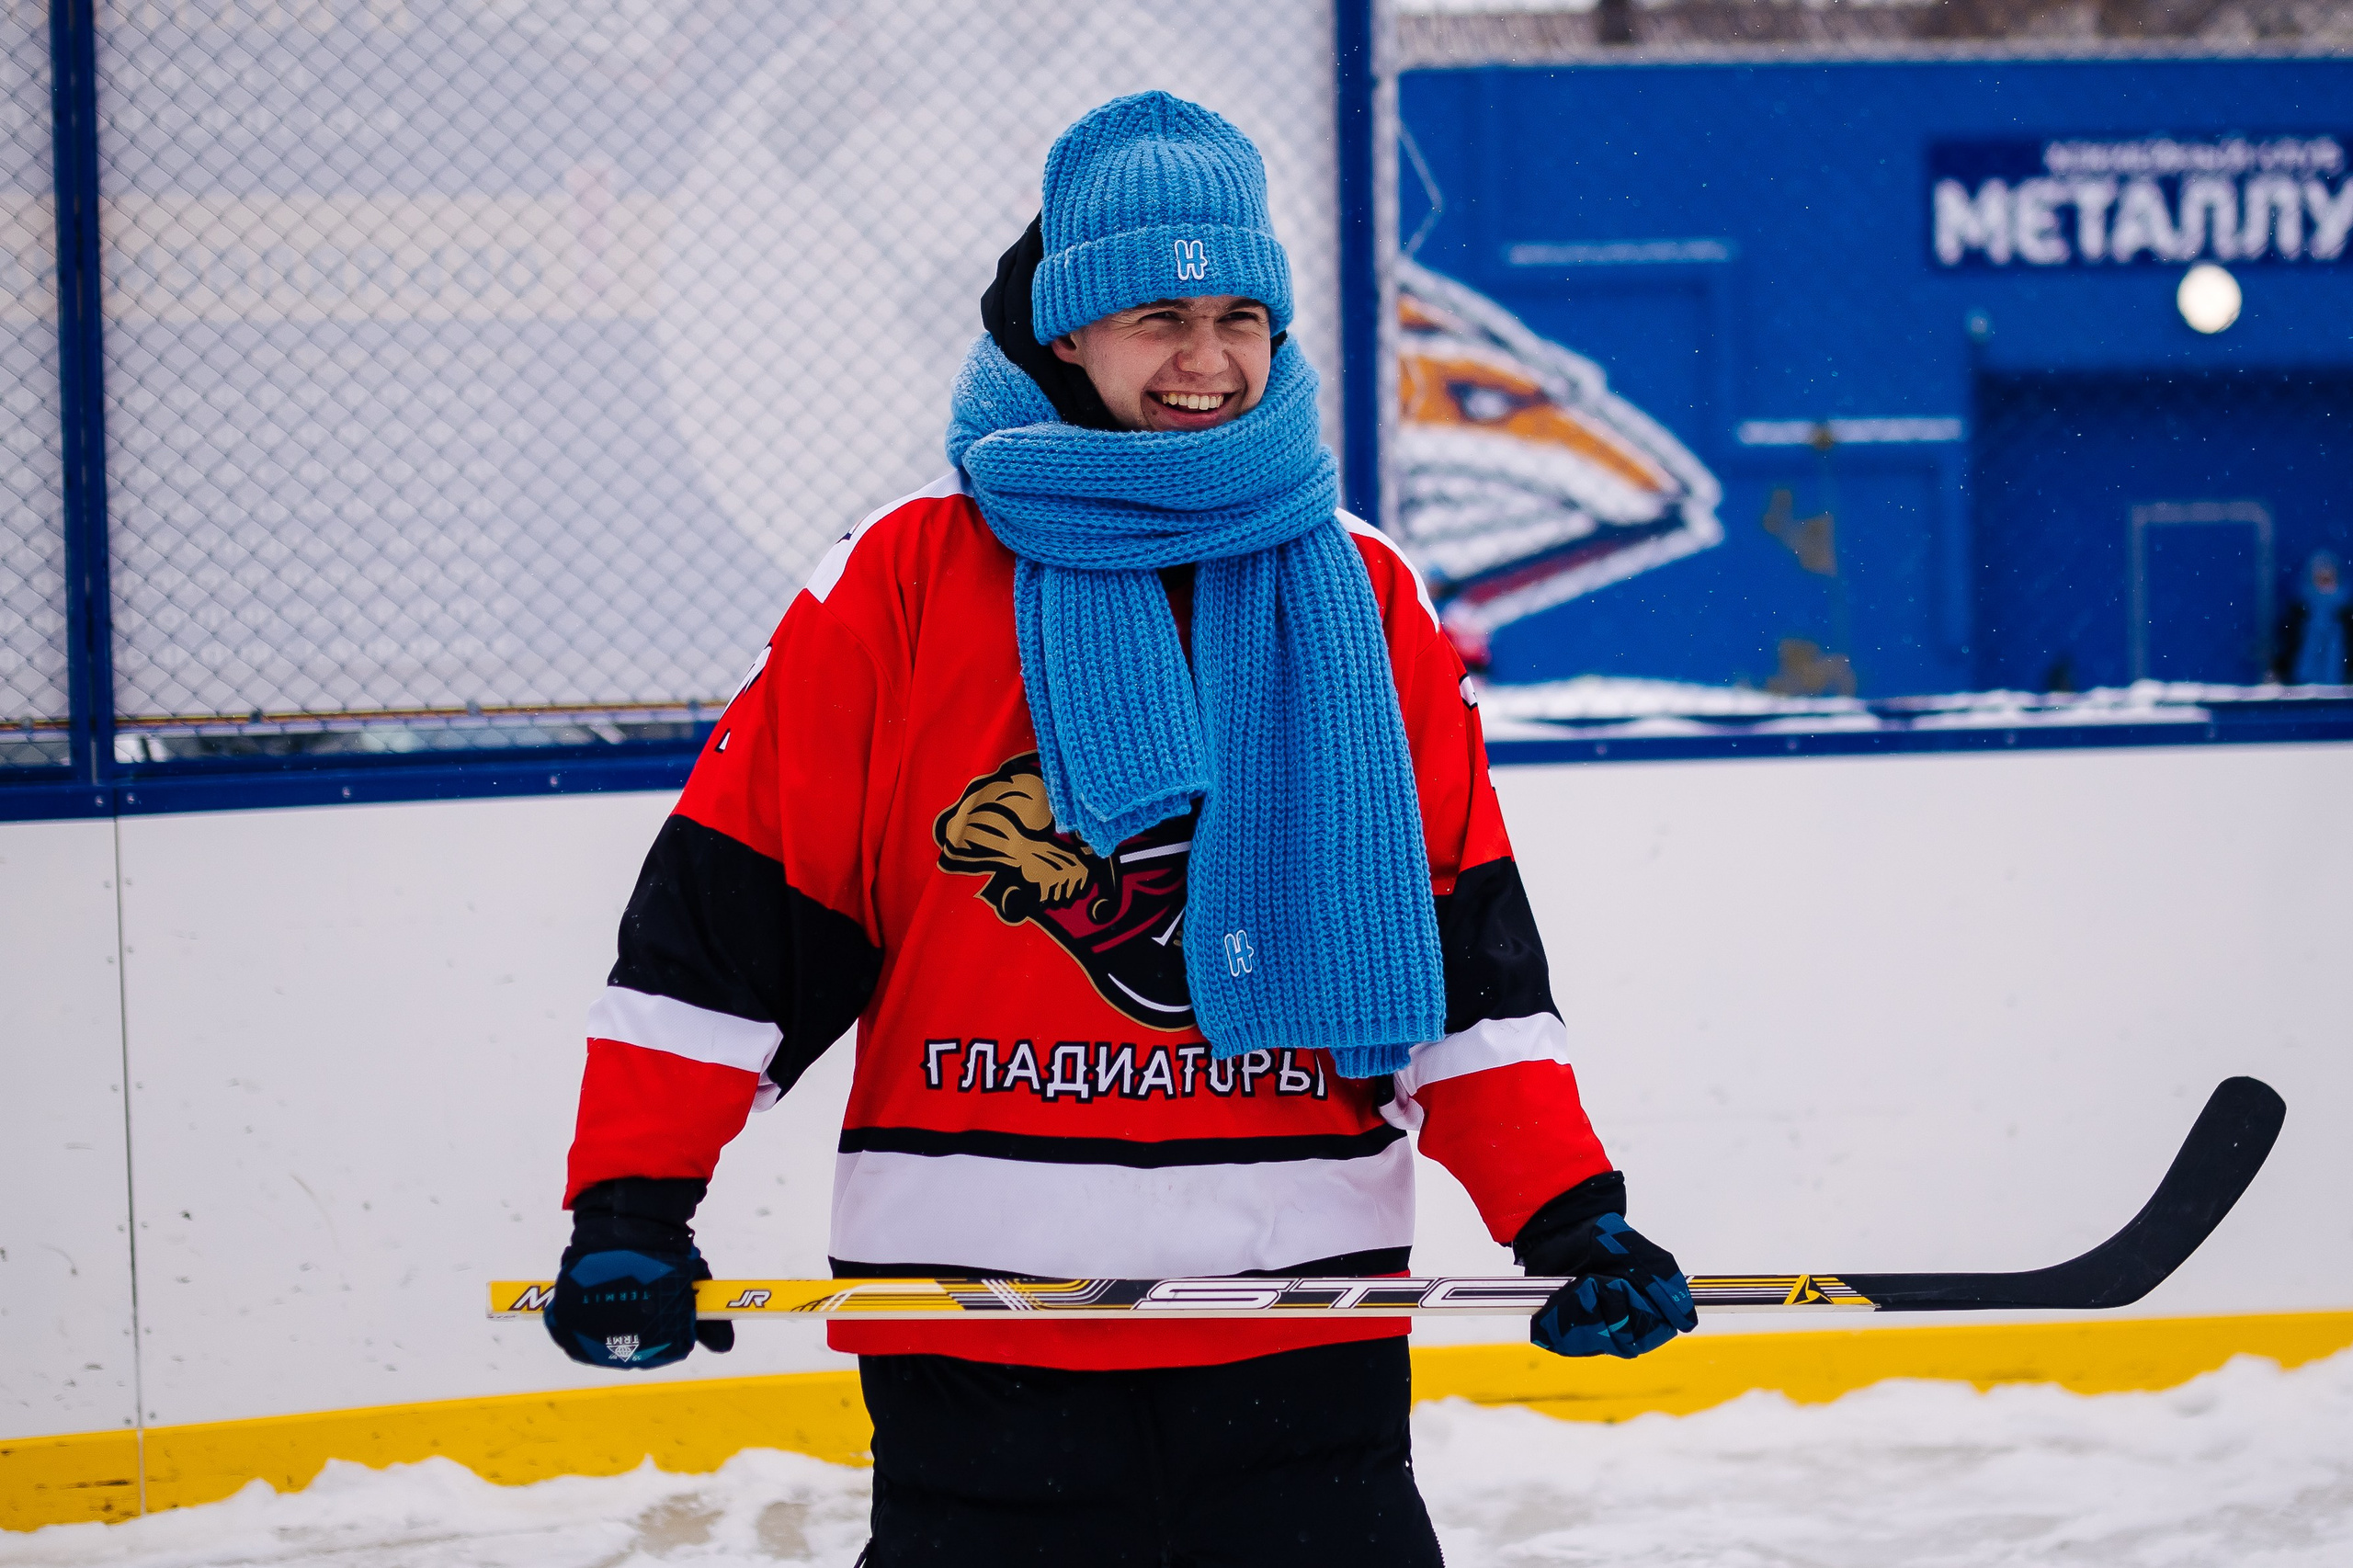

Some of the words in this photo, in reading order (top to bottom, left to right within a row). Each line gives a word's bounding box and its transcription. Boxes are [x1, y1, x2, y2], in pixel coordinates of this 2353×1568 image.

[1934, 176, 2353, 265] МЕТАЛЛУ
[921, 1039, 1329, 1102] ГЛАДИАТОРЫ
[582, 1290, 650, 1304] TERMIT
[726, 1290, 771, 1309] JR
[606, 1335, 640, 1345] TRMT
